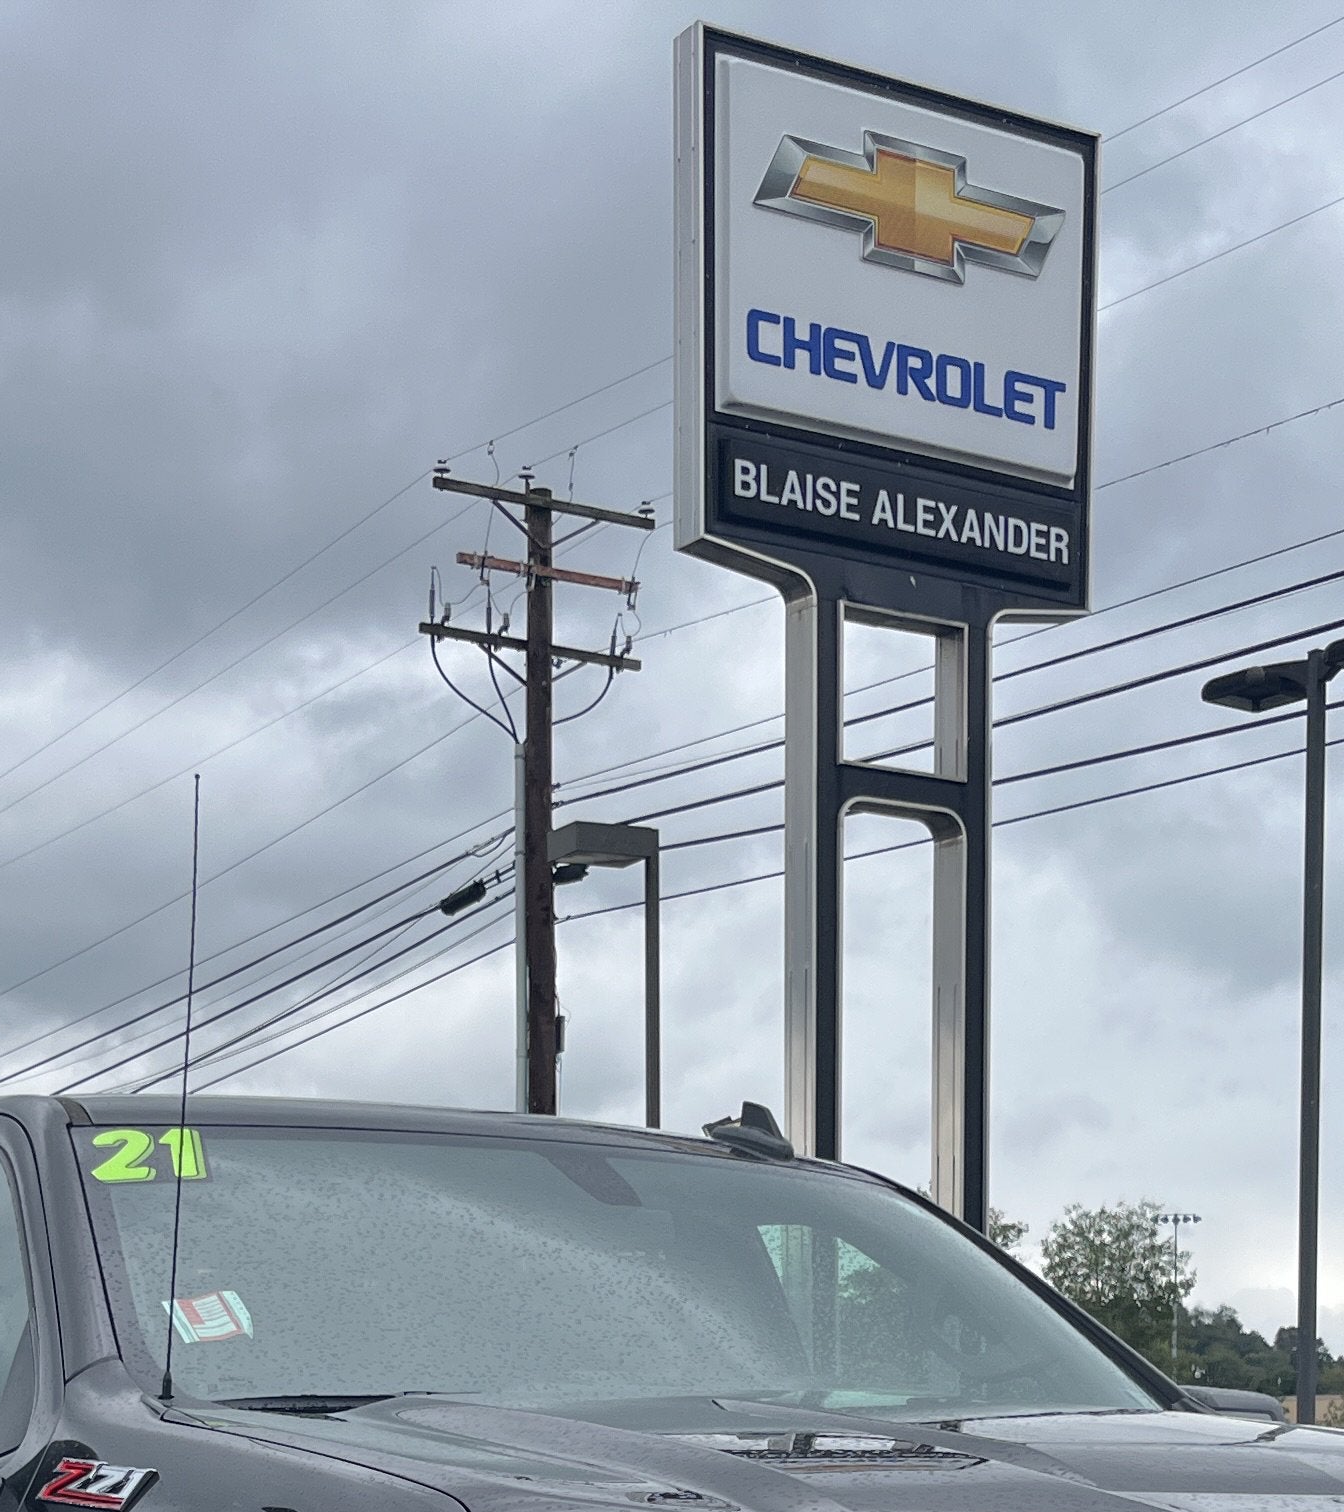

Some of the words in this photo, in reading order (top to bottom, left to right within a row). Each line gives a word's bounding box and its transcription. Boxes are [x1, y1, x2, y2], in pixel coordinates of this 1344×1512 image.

[747, 308, 1066, 430] CHEVROLET
[734, 458, 860, 522] BLAISE
[871, 489, 1070, 565] ALEXANDER
[90, 1128, 207, 1183] 21
